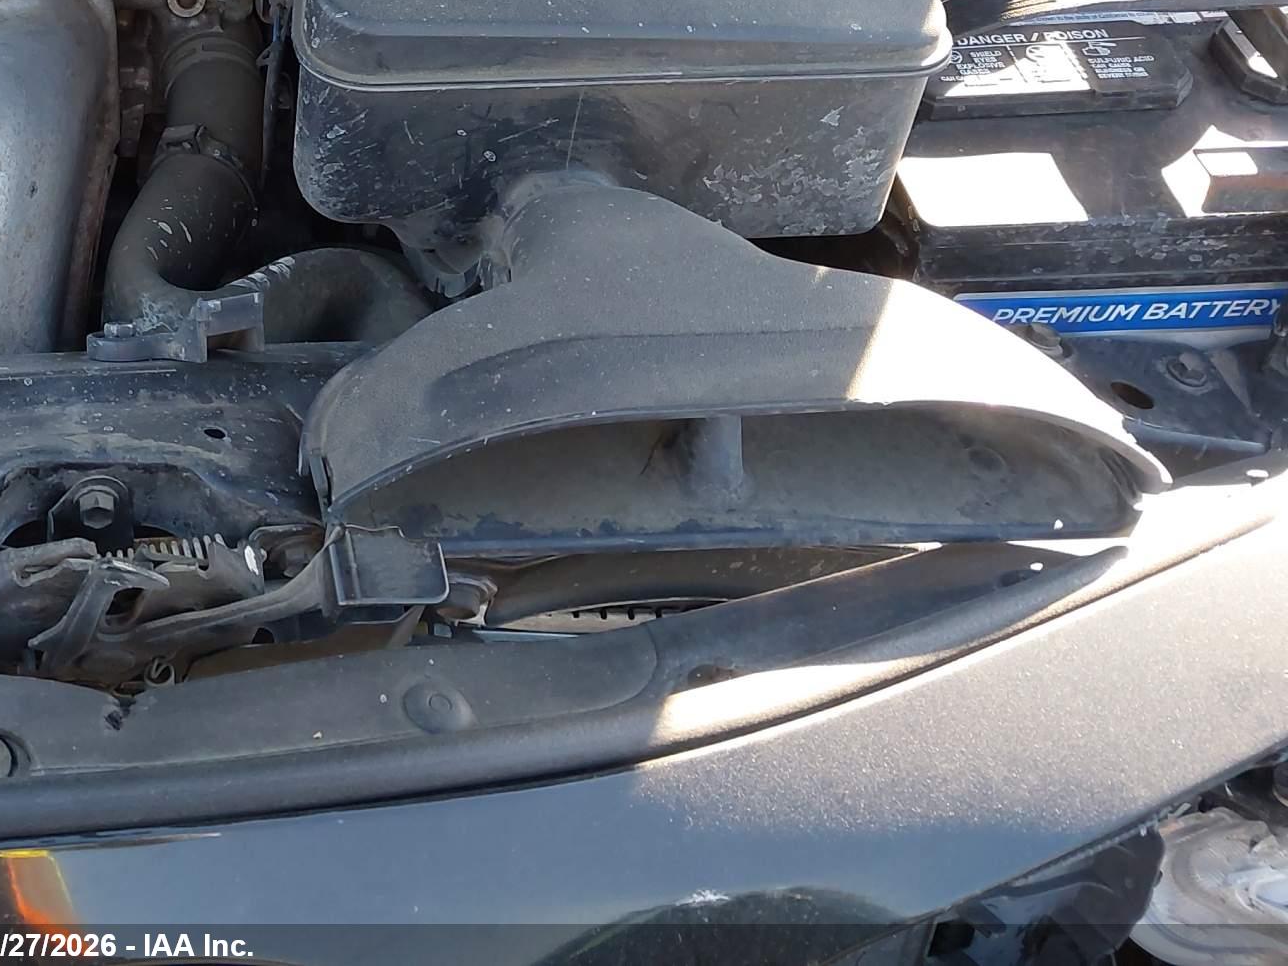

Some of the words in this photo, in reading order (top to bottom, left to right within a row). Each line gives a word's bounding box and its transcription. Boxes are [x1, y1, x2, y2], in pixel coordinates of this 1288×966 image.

[956, 33, 1028, 46] DANGER
[1043, 28, 1110, 42] POISON
[1133, 55, 1155, 63] ACID
[955, 62, 1006, 70] EXPLOSIVE
[992, 304, 1142, 325] PREMIUM
[1142, 299, 1280, 321] BATTERY
